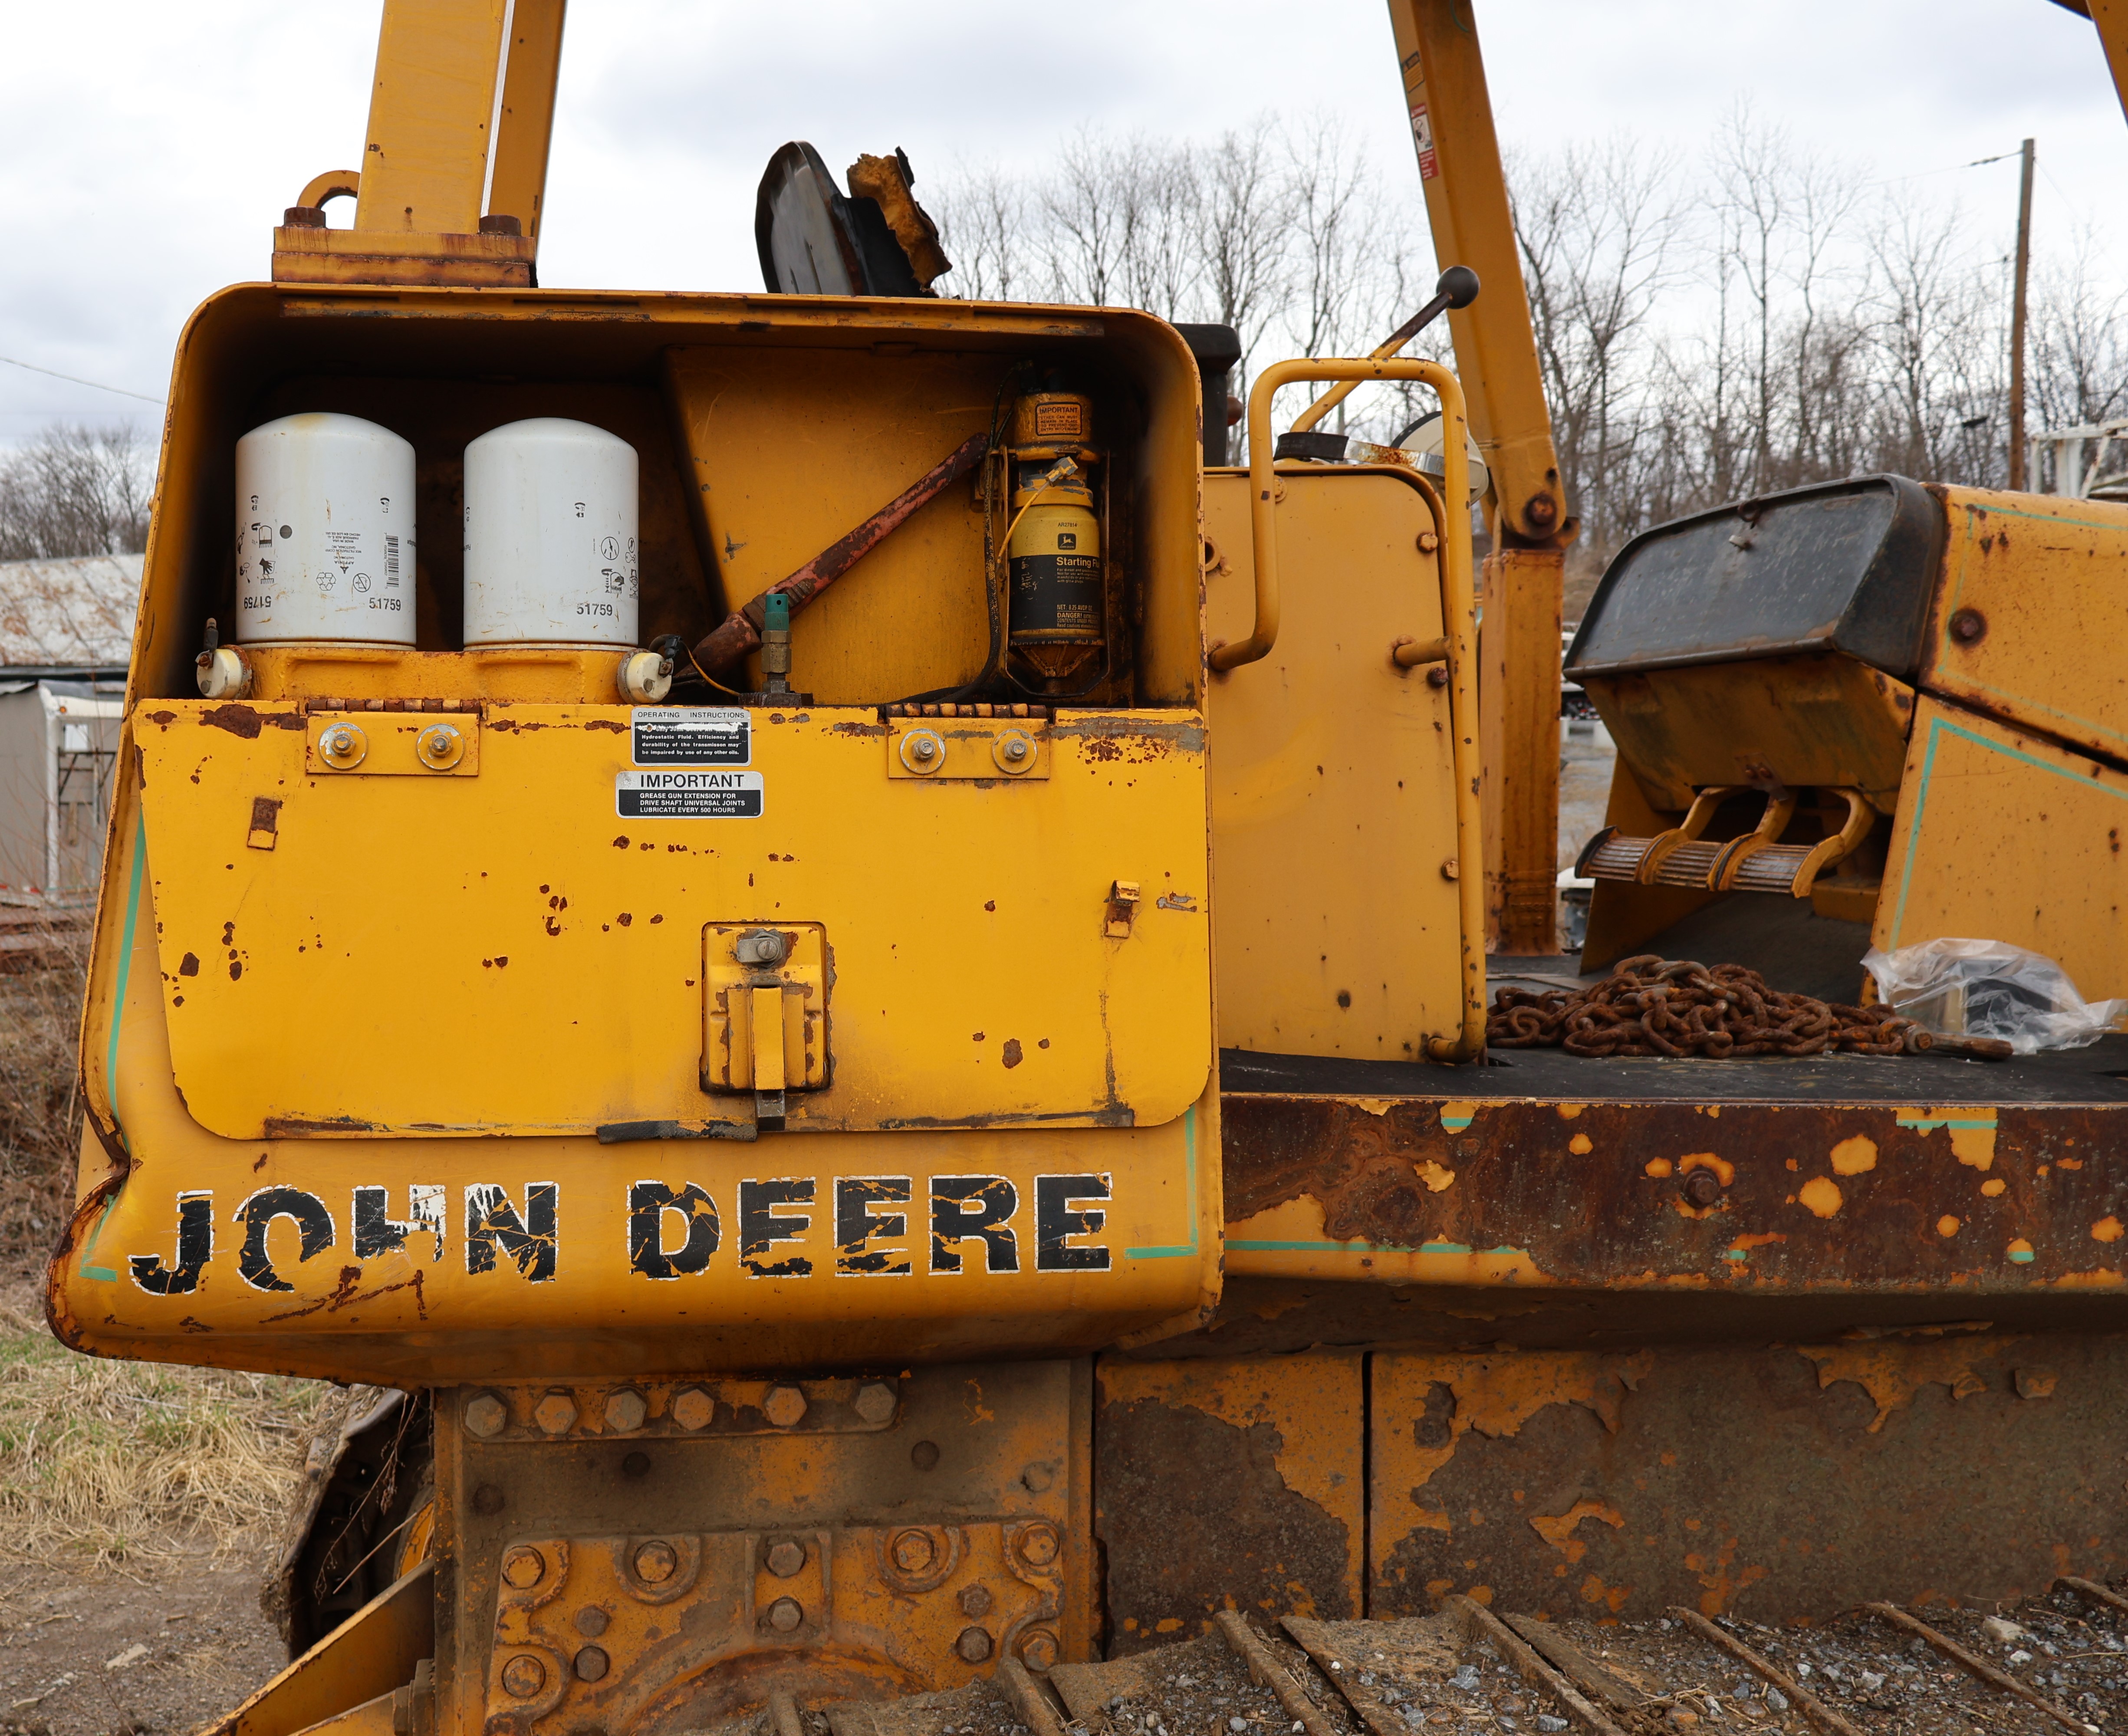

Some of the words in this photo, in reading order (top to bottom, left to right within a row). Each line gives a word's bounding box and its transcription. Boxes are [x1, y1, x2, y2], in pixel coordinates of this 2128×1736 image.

[1056, 557, 1091, 568] Starting
[244, 595, 271, 609] 51759
[369, 597, 401, 611] 51759
[576, 602, 612, 616] 51759
[641, 774, 744, 788] IMPORTANT
[128, 1181, 559, 1295] JOHN
[626, 1171, 1113, 1281] DEERE
